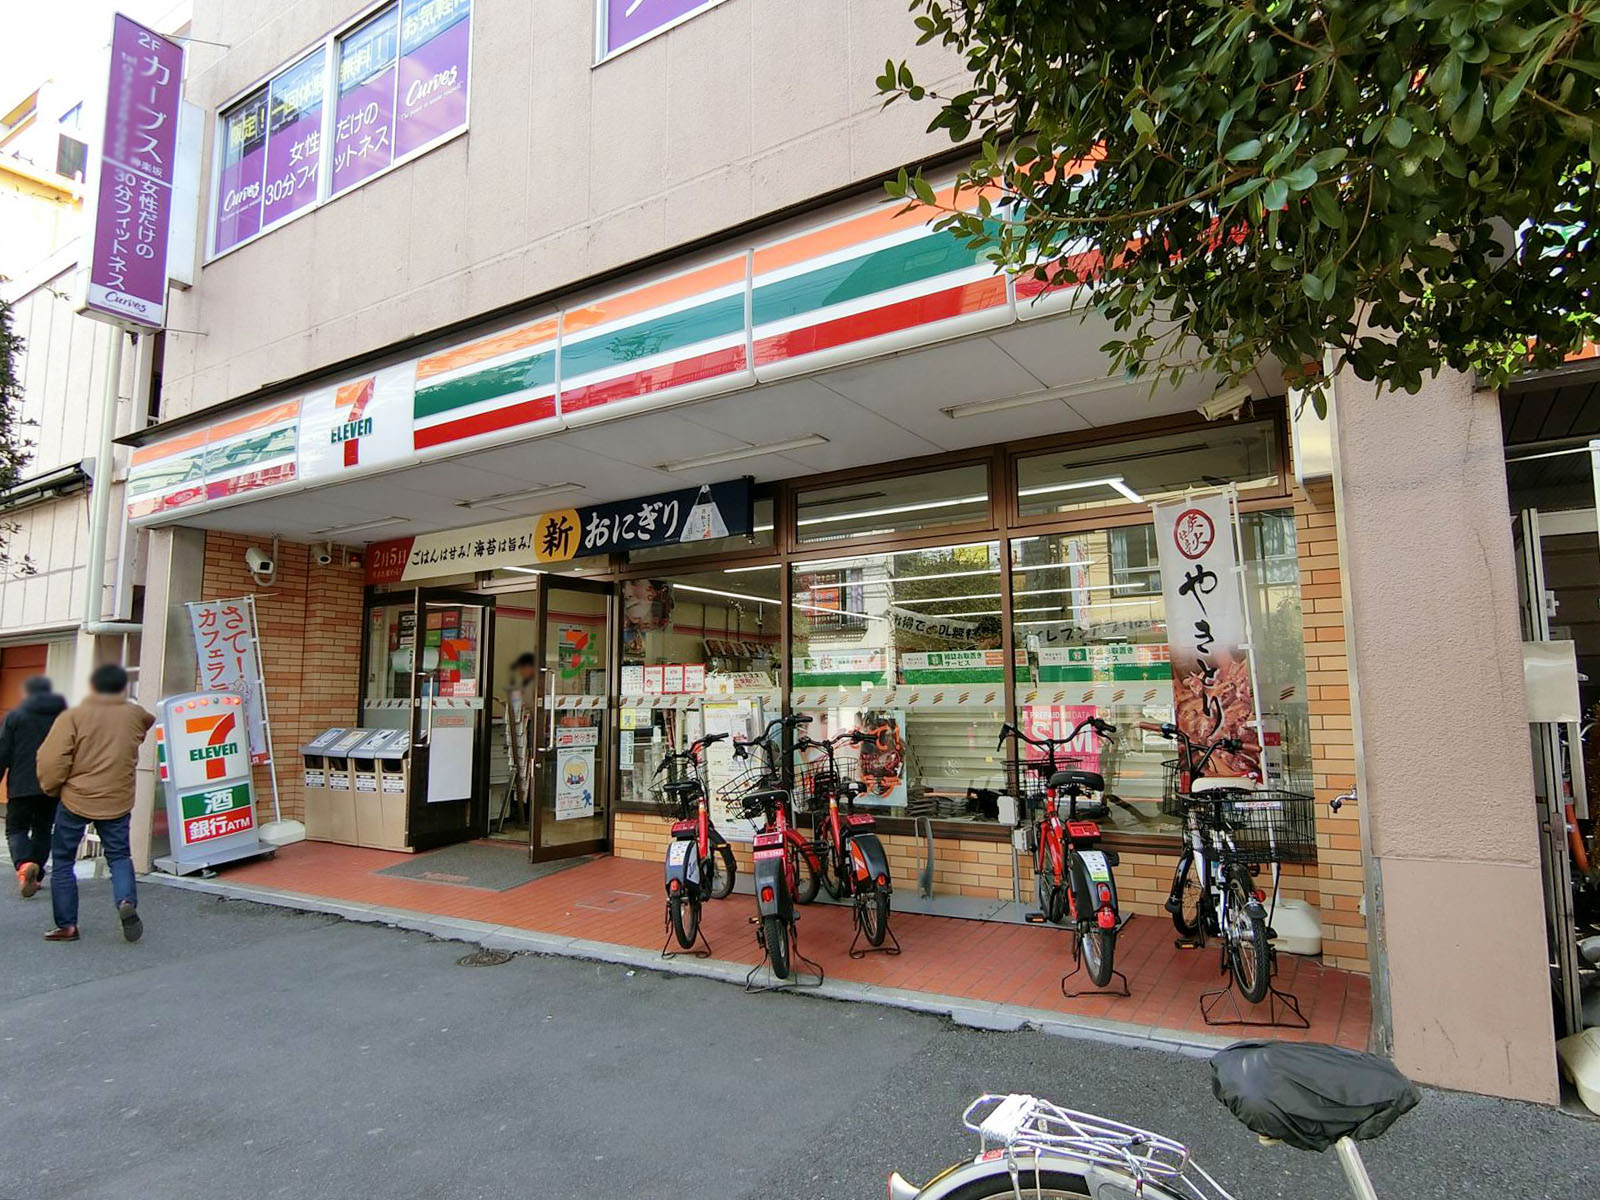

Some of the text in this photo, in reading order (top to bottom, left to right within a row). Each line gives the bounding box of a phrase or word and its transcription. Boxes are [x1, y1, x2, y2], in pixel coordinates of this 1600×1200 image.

[138, 31, 160, 49] 2F
[406, 65, 458, 107] Curves
[131, 56, 170, 164] カーブス
[223, 182, 261, 212] Curves
[106, 168, 137, 291] 30分フィットネス
[136, 180, 160, 259] 女性だけの
[105, 290, 147, 313] Curves
[543, 516, 574, 557] 新
[584, 500, 679, 549] おにぎり
[1178, 564, 1223, 738] やきとり
[1031, 720, 1092, 753] SIM
[203, 789, 234, 815] 酒
[188, 816, 251, 840] 銀行 ATM
